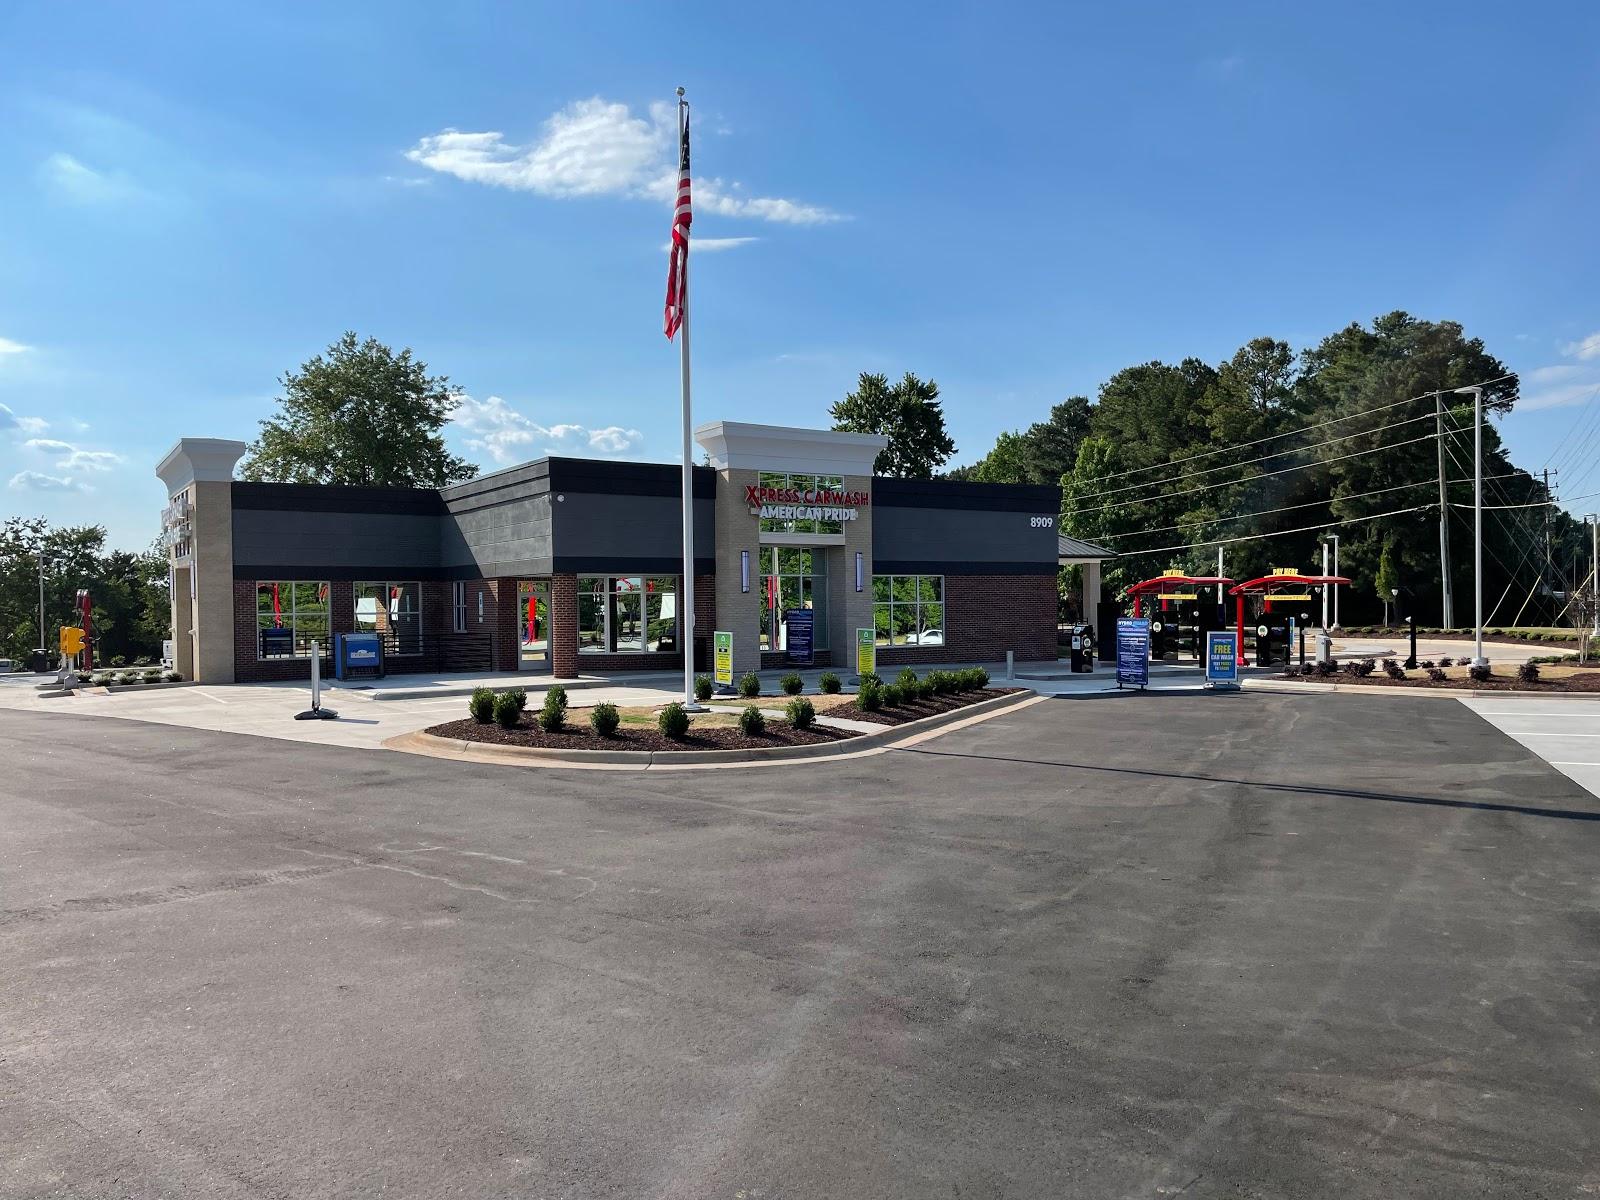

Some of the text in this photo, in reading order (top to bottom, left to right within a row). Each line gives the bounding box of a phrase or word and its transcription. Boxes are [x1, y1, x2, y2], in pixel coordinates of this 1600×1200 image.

[745, 485, 869, 508] XPRESS CARWASH
[760, 506, 856, 521] AMERICAN PRIDE
[1030, 516, 1053, 528] 8909
[1273, 568, 1299, 576] PAY HERE
[1214, 645, 1232, 654] FREE
